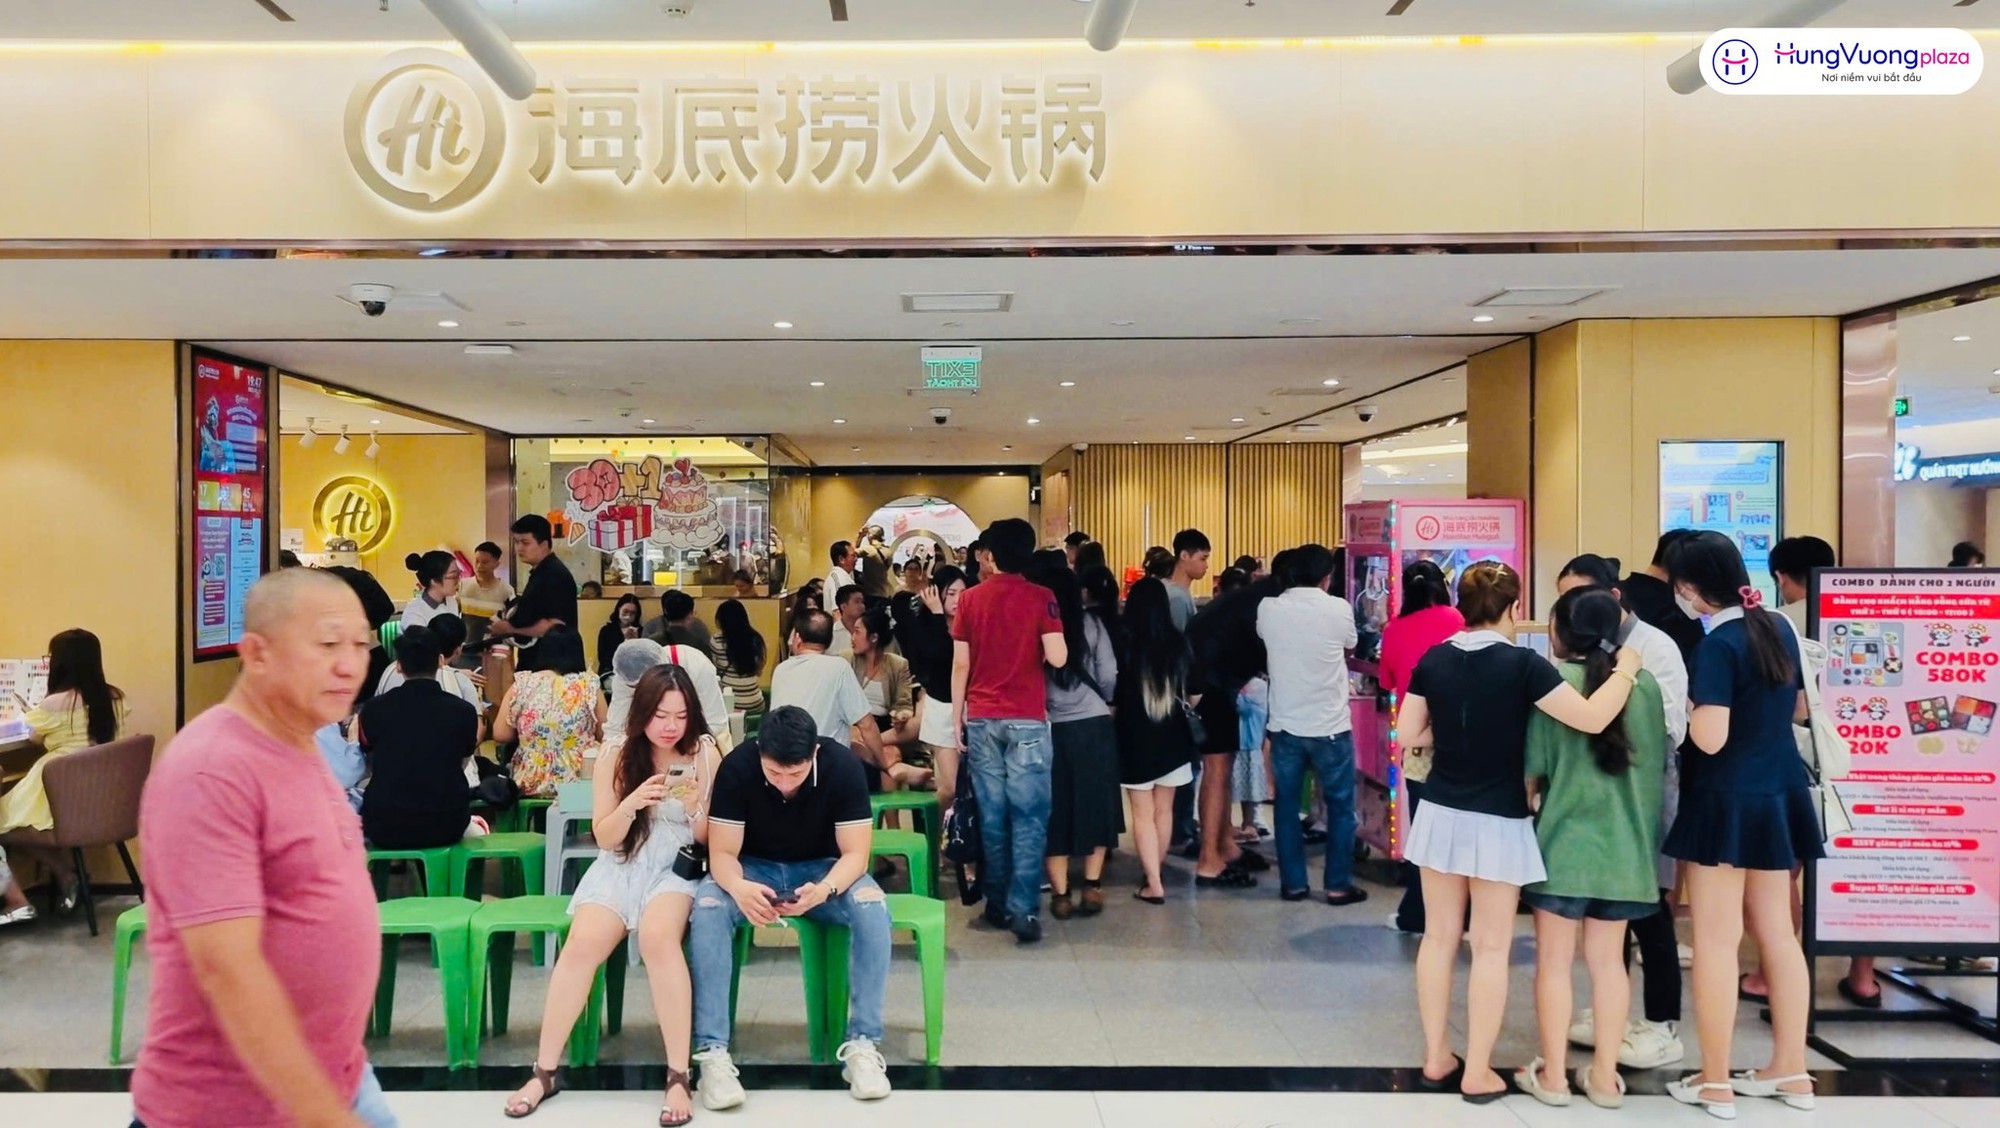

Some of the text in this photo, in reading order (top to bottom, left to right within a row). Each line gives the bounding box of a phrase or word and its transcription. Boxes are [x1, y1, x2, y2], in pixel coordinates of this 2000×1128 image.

[527, 73, 1107, 185] 海底捞火锅
[1832, 578, 1874, 587] COMBO
[1919, 579, 1944, 587] CHO
[1916, 651, 1999, 666] COMBO
[1927, 669, 1986, 683] 580K
[1837, 725, 1901, 739] OMBO
